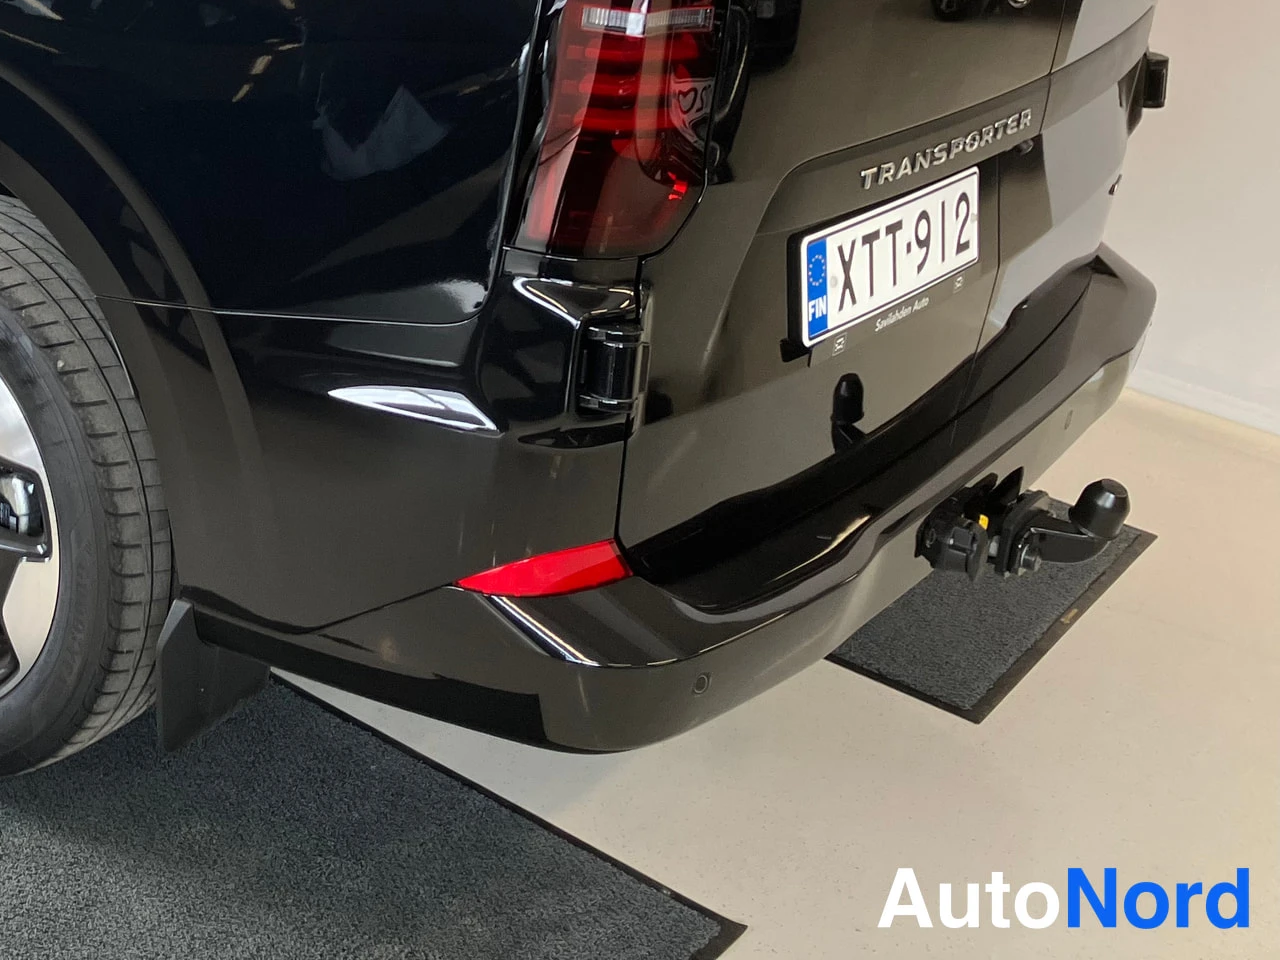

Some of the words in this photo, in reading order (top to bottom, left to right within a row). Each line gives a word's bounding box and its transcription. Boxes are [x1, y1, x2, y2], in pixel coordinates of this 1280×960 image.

[860, 108, 1032, 190] TRANSPORTER
[837, 192, 971, 313] XTT-912
[808, 295, 827, 322] FIN
[912, 297, 930, 313] Auto
